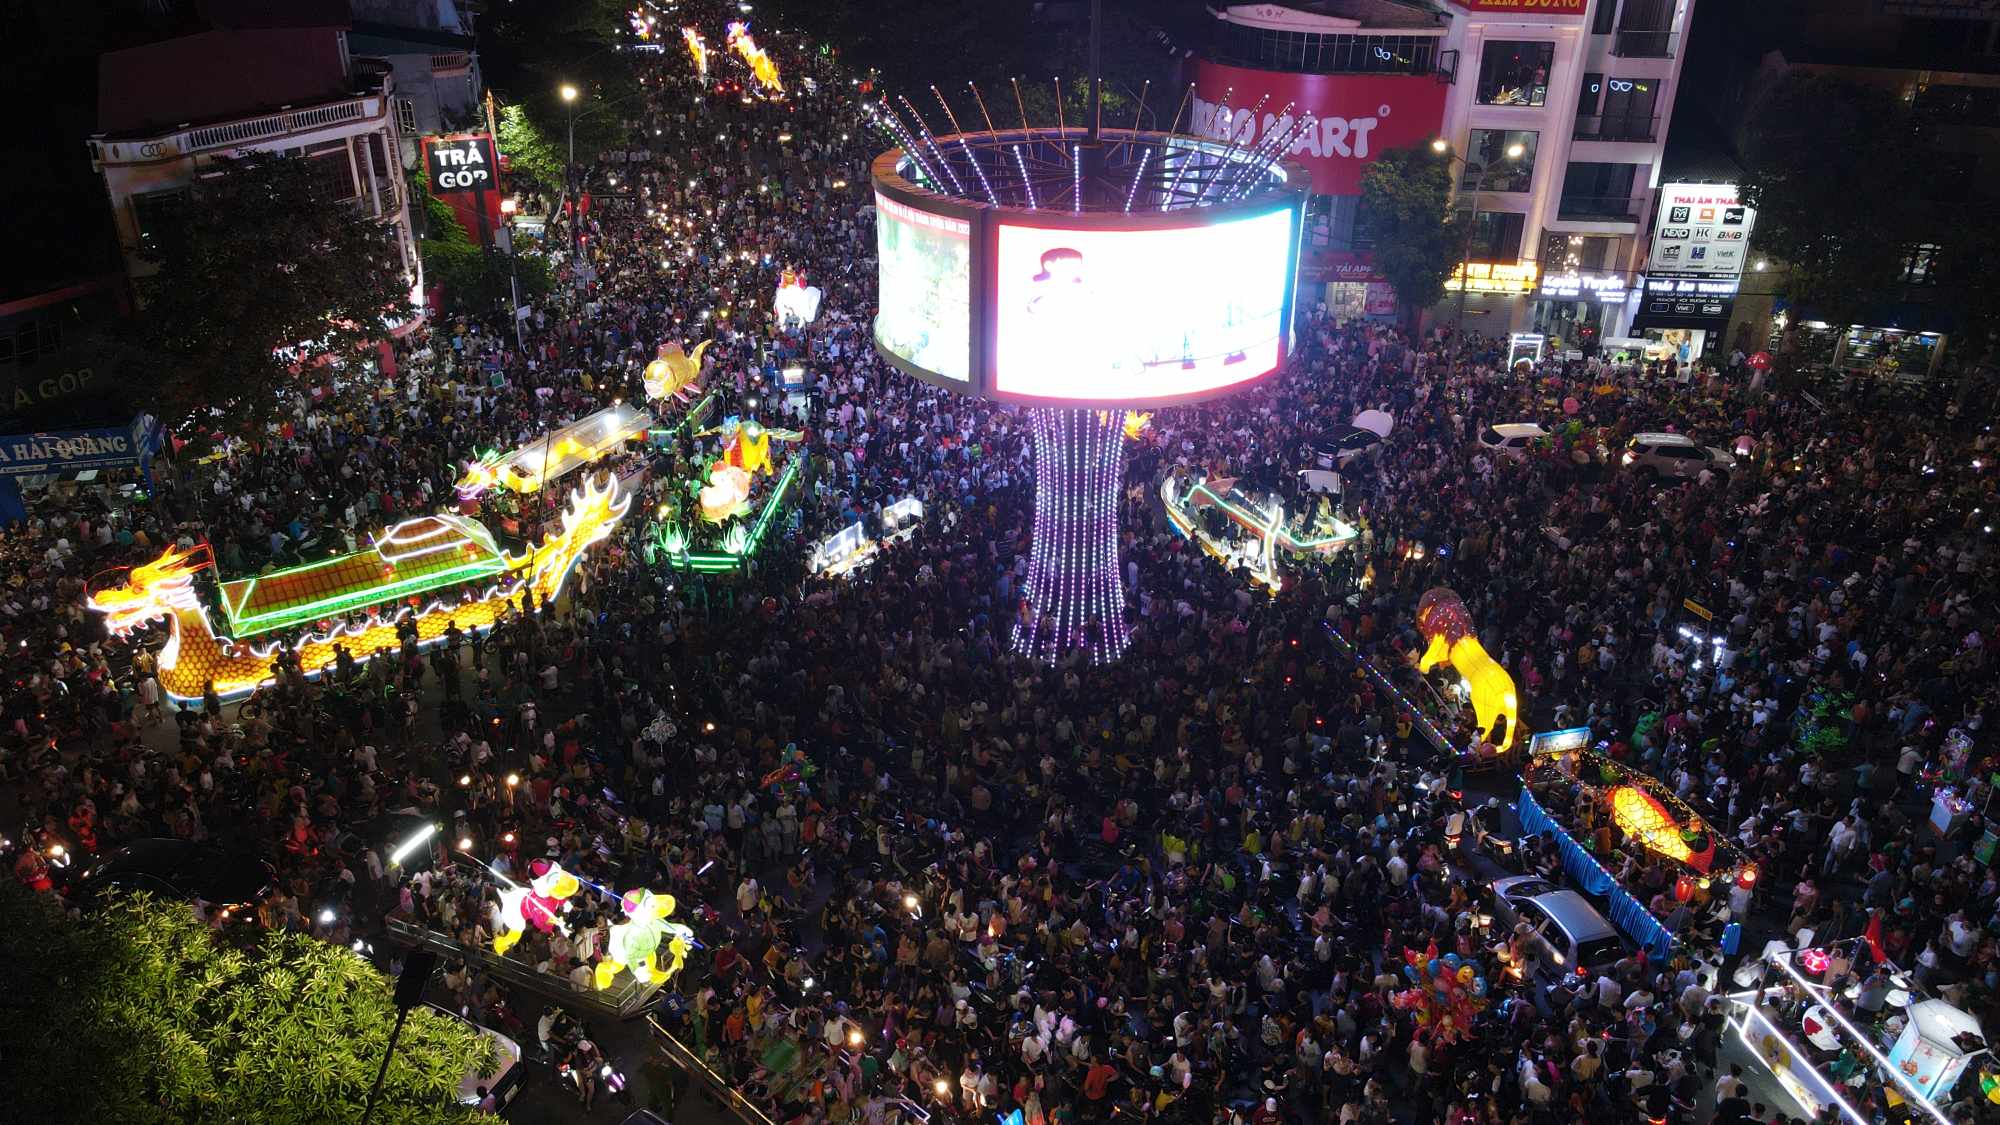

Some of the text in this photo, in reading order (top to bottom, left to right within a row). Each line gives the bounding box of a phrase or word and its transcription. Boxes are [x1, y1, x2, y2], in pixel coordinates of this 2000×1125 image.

[1260, 112, 1378, 158] MART
[434, 141, 484, 166] TRẢ
[1717, 231, 1743, 240] BMB
